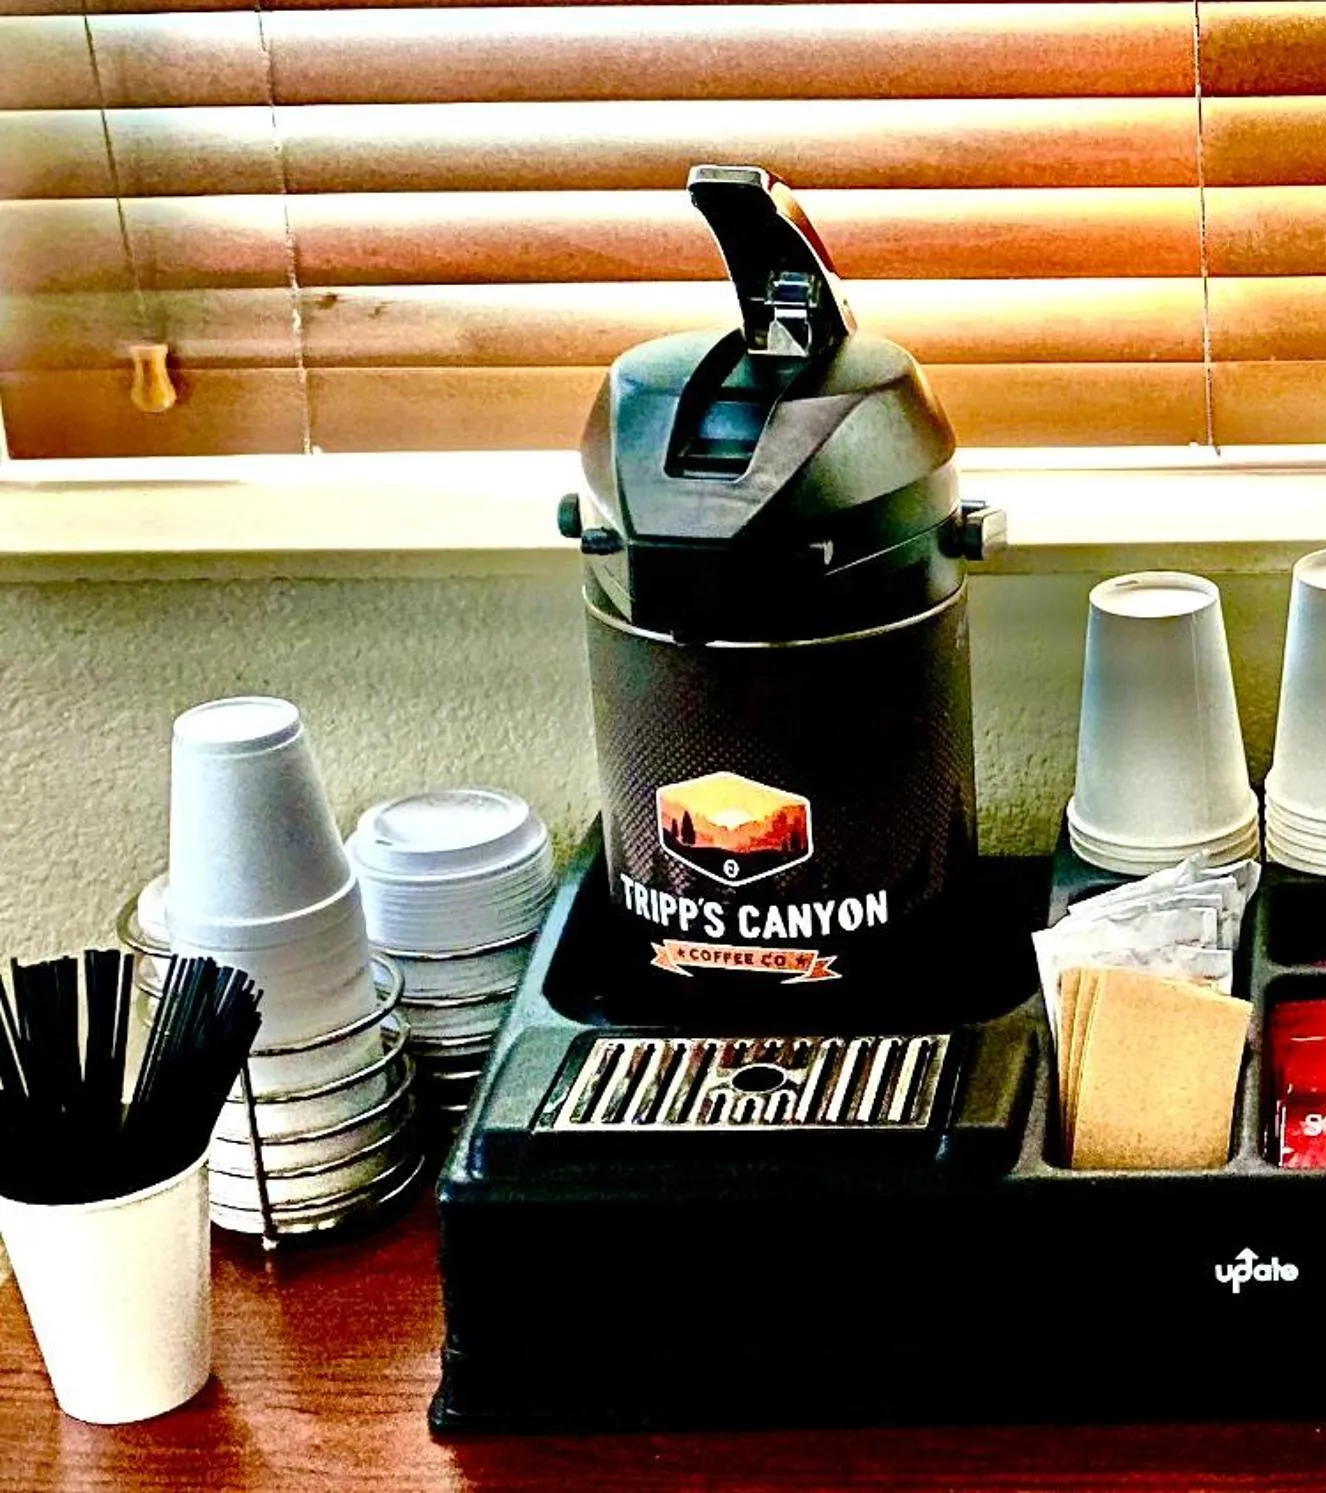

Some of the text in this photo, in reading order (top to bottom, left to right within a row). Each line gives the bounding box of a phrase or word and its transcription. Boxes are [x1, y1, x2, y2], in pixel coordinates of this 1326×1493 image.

[620, 872, 889, 940] TRIPP'S CANYON
[689, 947, 754, 966] COFFEE
